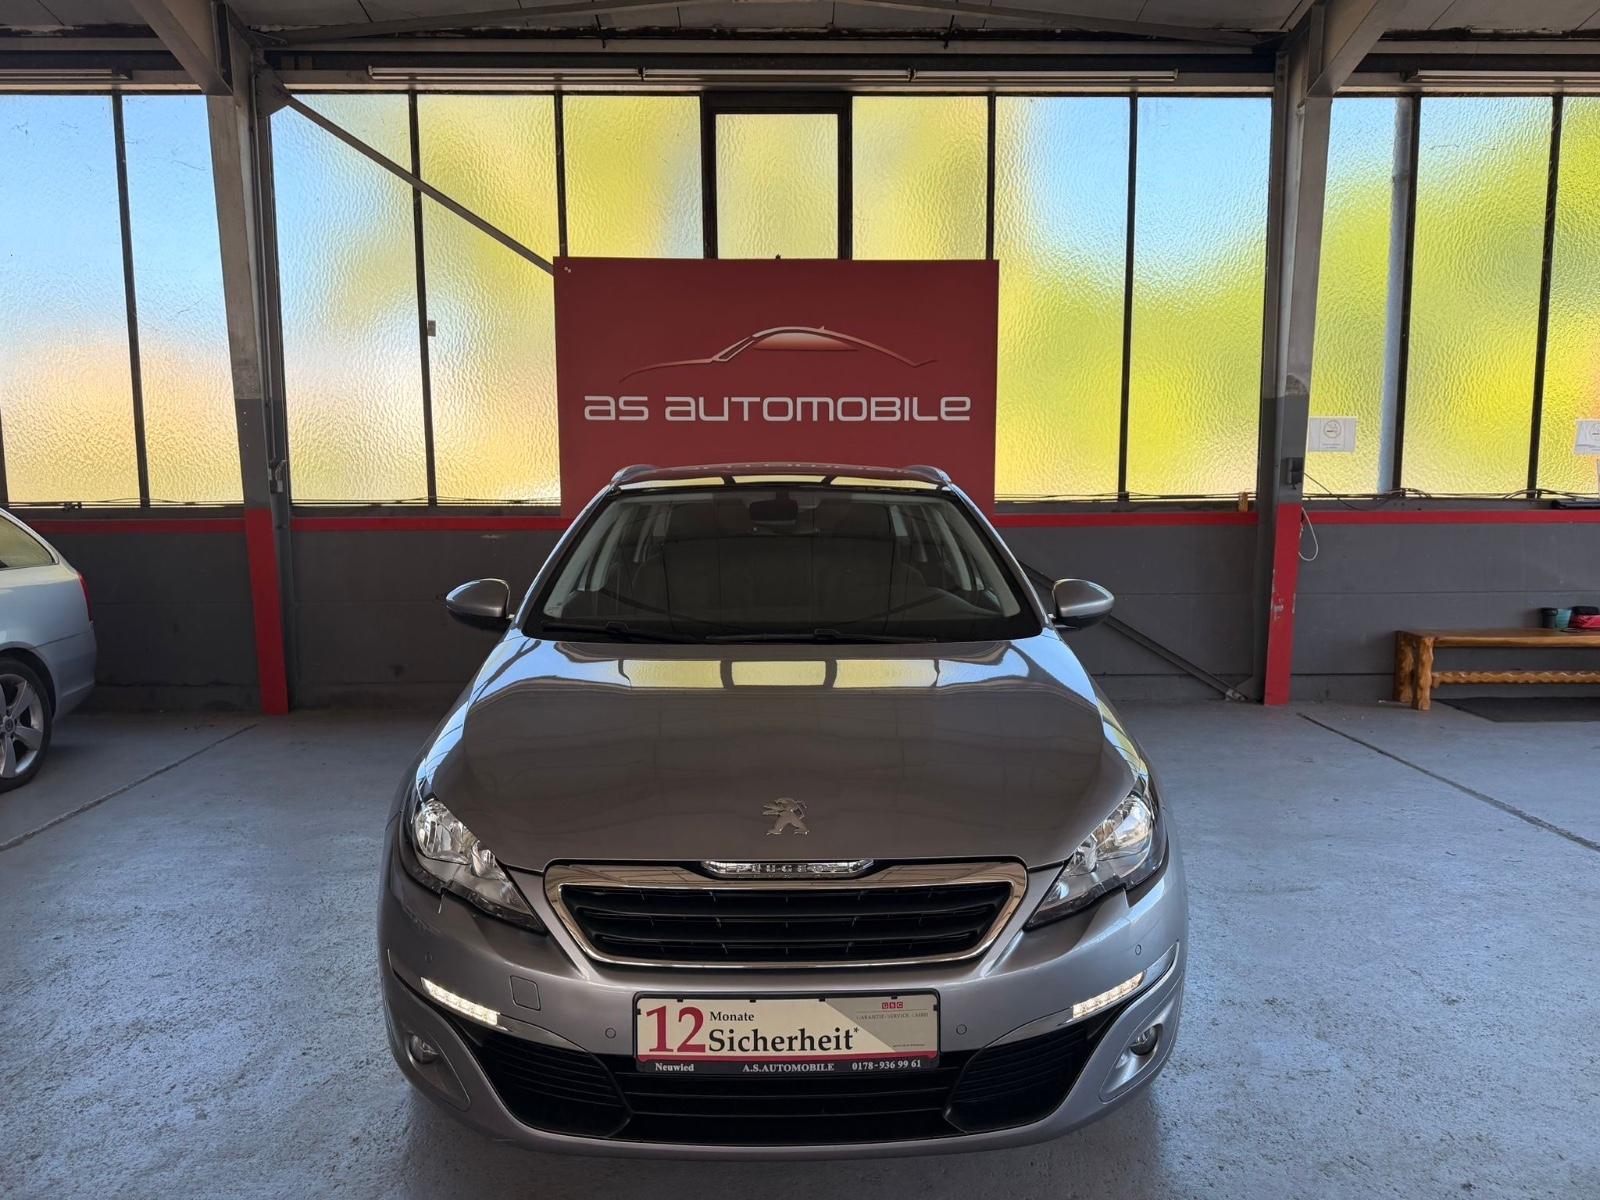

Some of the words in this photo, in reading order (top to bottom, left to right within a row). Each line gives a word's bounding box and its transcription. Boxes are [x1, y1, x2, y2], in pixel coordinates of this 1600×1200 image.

[709, 1011, 755, 1022] Monate
[646, 1005, 706, 1053] 12
[655, 1062, 695, 1072] Neuwied
[742, 1063, 835, 1073] A.S.AUTOMOBILE
[897, 1061, 909, 1069] 99
[911, 1060, 922, 1068] 61
